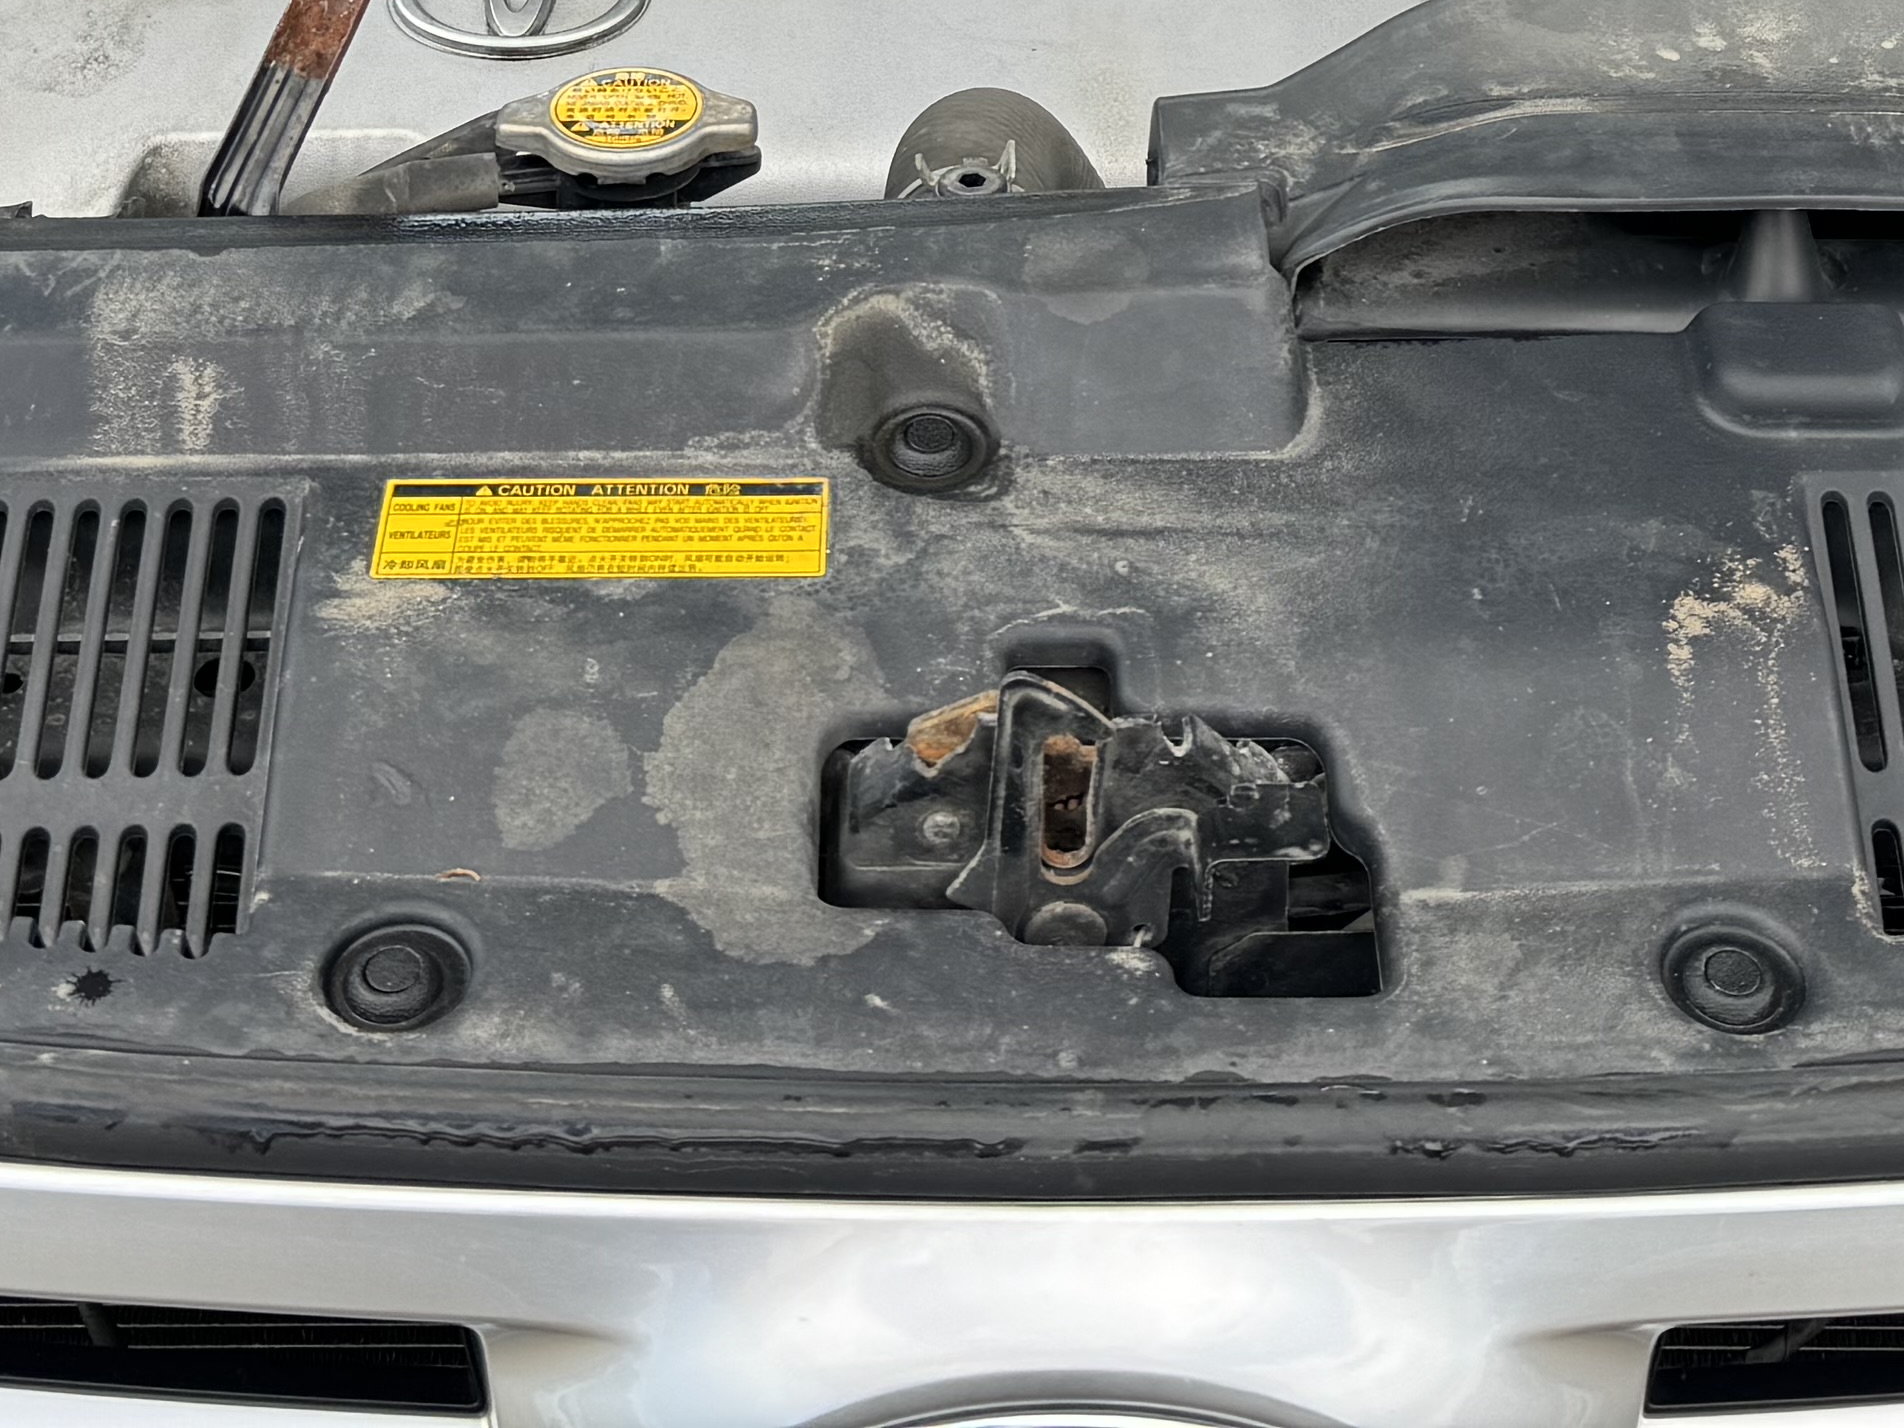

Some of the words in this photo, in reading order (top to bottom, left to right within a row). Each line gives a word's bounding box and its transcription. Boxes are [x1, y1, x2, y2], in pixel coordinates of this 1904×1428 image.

[601, 79, 671, 87] CAUTION
[498, 484, 576, 497] CAUTION
[591, 483, 690, 497] ATTENTION
[393, 503, 431, 512] COOLING
[434, 503, 456, 512] FANS
[389, 530, 451, 540] VENTILATEURS
[382, 559, 448, 570] 冷却风扇
